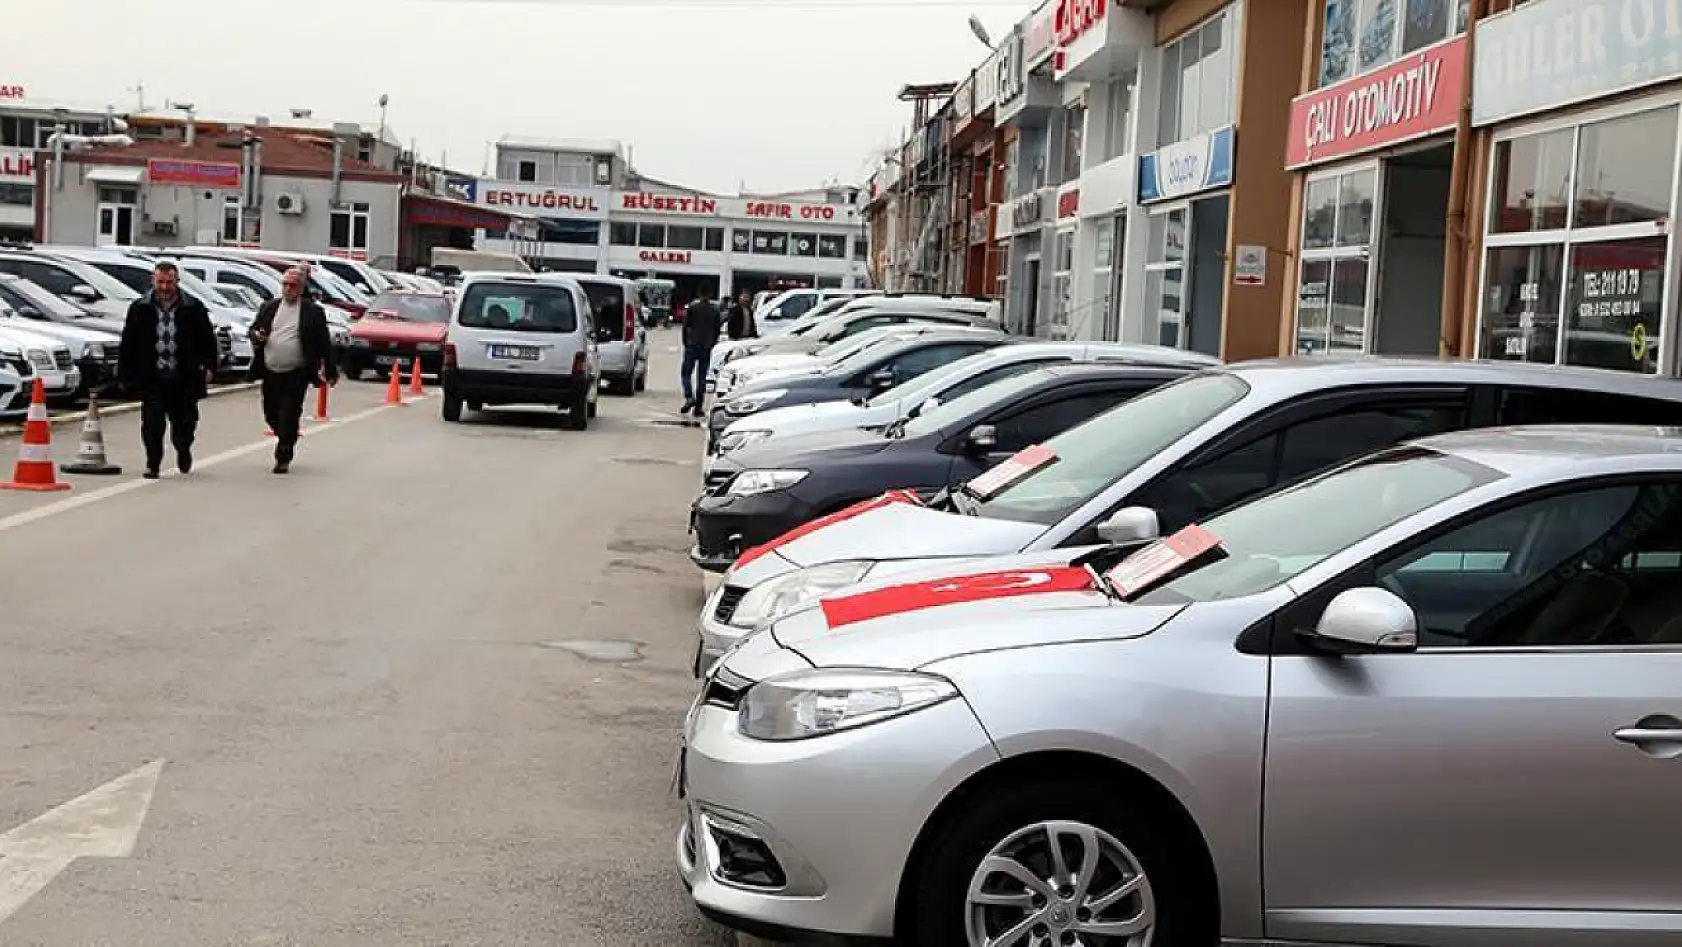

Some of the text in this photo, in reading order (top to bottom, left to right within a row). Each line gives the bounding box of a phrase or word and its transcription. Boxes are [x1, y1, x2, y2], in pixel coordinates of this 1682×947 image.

[1306, 54, 1442, 162] ÇALI OTOMOTİV
[486, 189, 600, 211] ERTUĞRUL
[623, 192, 716, 213] HÜSEYİN
[800, 206, 834, 219] OTO
[640, 251, 691, 264] GALERİ
